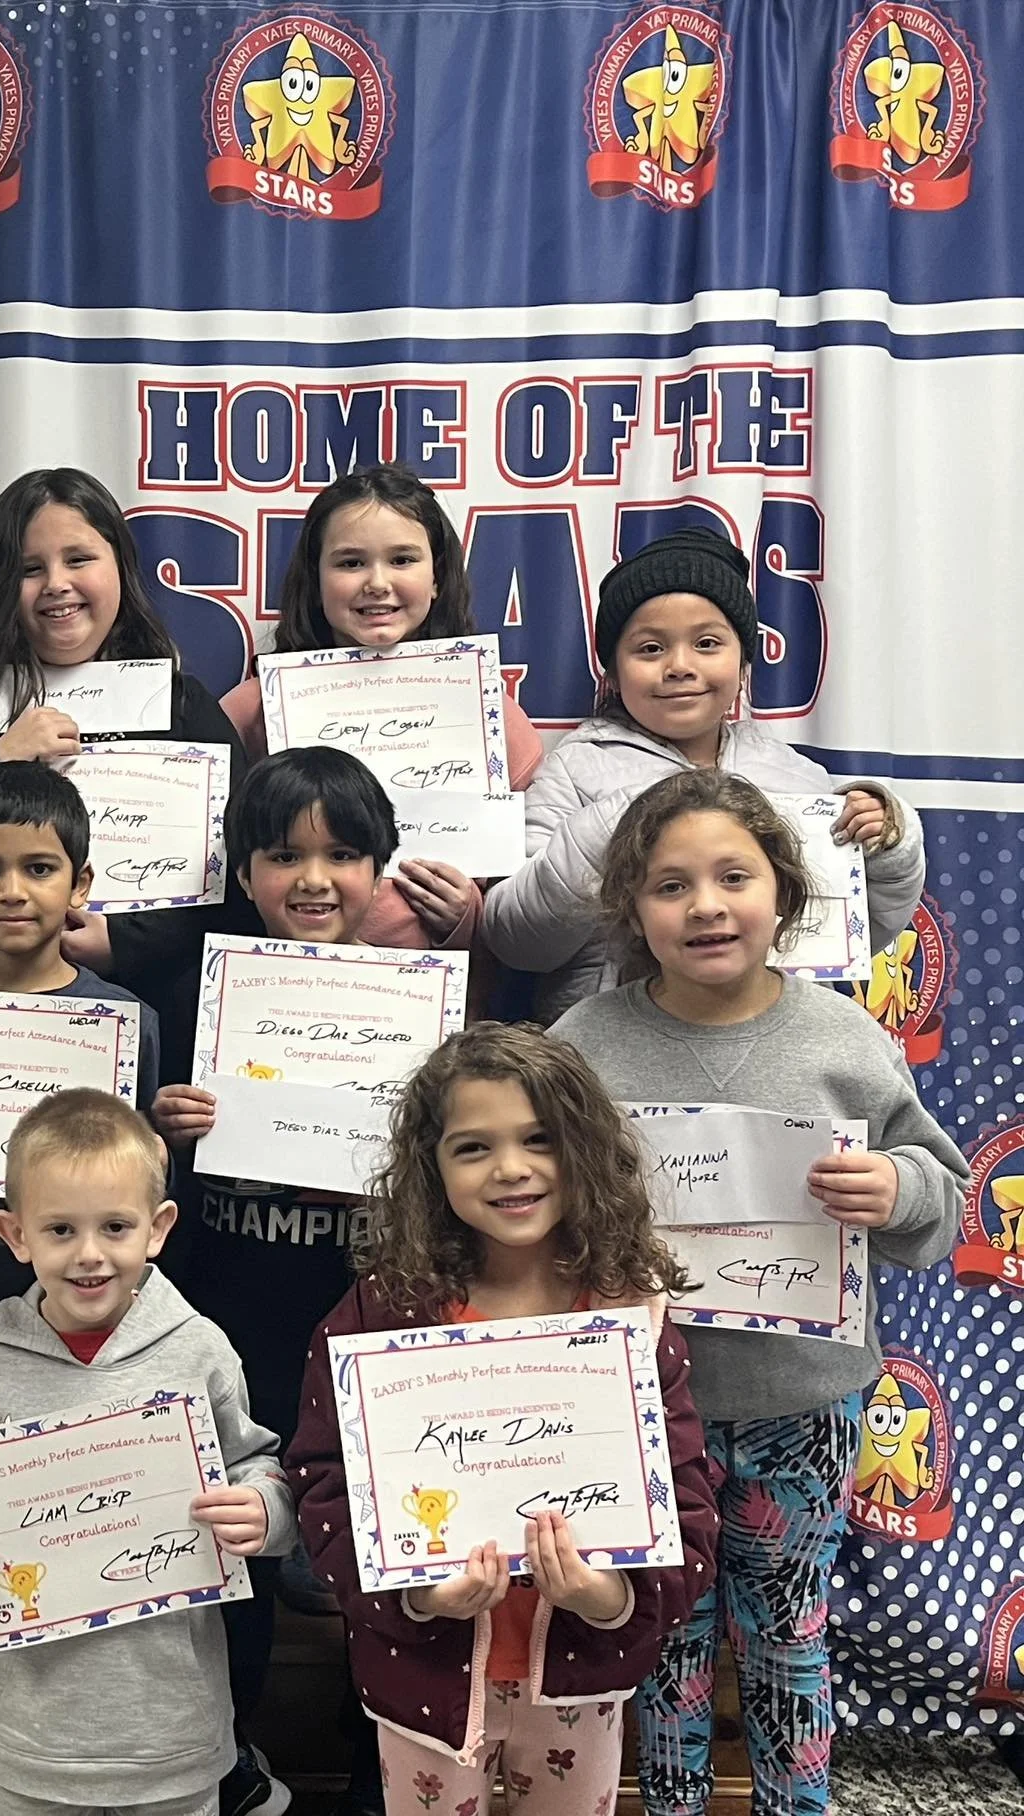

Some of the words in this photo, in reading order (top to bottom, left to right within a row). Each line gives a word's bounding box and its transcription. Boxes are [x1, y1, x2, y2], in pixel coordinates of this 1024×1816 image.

[261, 22, 301, 42] YATES
[304, 23, 358, 61] PRIMARY
[672, 13, 718, 44] PRIMAR
[897, 10, 947, 46] PRIMARY
[0, 64, 17, 105] YATES
[218, 44, 251, 101] PRIMARY
[599, 36, 633, 97] PRIMARY
[949, 58, 968, 101] YATES
[359, 69, 379, 111] YATES
[842, 85, 856, 125] YATES
[217, 105, 233, 146] YATES
[598, 101, 612, 142] YATES
[935, 105, 968, 167] PRIMARY
[349, 115, 378, 177] PRIMARY
[255, 171, 333, 215] STARS
[139, 380, 467, 492] HOME
[496, 376, 641, 486] OF
[655, 363, 814, 481] THE
[348, 741, 429, 756] Congratulations!
[921, 926, 939, 968] YATES
[232, 976, 276, 990] ZAXBY'S
[279, 978, 313, 990] Monthly
[316, 978, 348, 990] Perfect
[351, 981, 401, 997] Attendance
[404, 989, 433, 1003] Award
[914, 970, 939, 1024] PRIMARY
[27, 1031, 77, 1046] Attendance
[79, 1040, 108, 1053] Award
[284, 1046, 376, 1065] Congratulations!
[654, 1149, 728, 1172] XAVIANNA
[203, 1194, 374, 1249] CHAMPIO
[964, 1197, 978, 1235] YATES
[372, 1376, 424, 1399] ZAXBY'S
[426, 1369, 468, 1386] Monthly
[472, 1365, 511, 1379] Perfect
[514, 1363, 577, 1375] Attendance
[581, 1363, 618, 1377] Award
[892, 1363, 930, 1391] PRIMARY
[443, 1410, 475, 1421] AWARD
[486, 1408, 511, 1417] BEING
[513, 1403, 560, 1415] PRESENTED
[563, 1402, 576, 1410] TO
[932, 1400, 944, 1441] YATES
[8, 1457, 47, 1476] Monthly
[49, 1446, 85, 1468] Perfect
[89, 1436, 145, 1456] Attendance
[148, 1432, 181, 1445] Award
[453, 1451, 566, 1476] Congratulations!
[929, 1443, 945, 1501] PRIMARY
[27, 1491, 55, 1504] AWARD
[89, 1473, 133, 1491] PRESENTED
[134, 1470, 145, 1479] TO
[40, 1513, 141, 1547] Congratulations!
[394, 1531, 420, 1541] ZAXBYS
[853, 1495, 917, 1538] TARS
[994, 1610, 1014, 1668] PRIMARY
